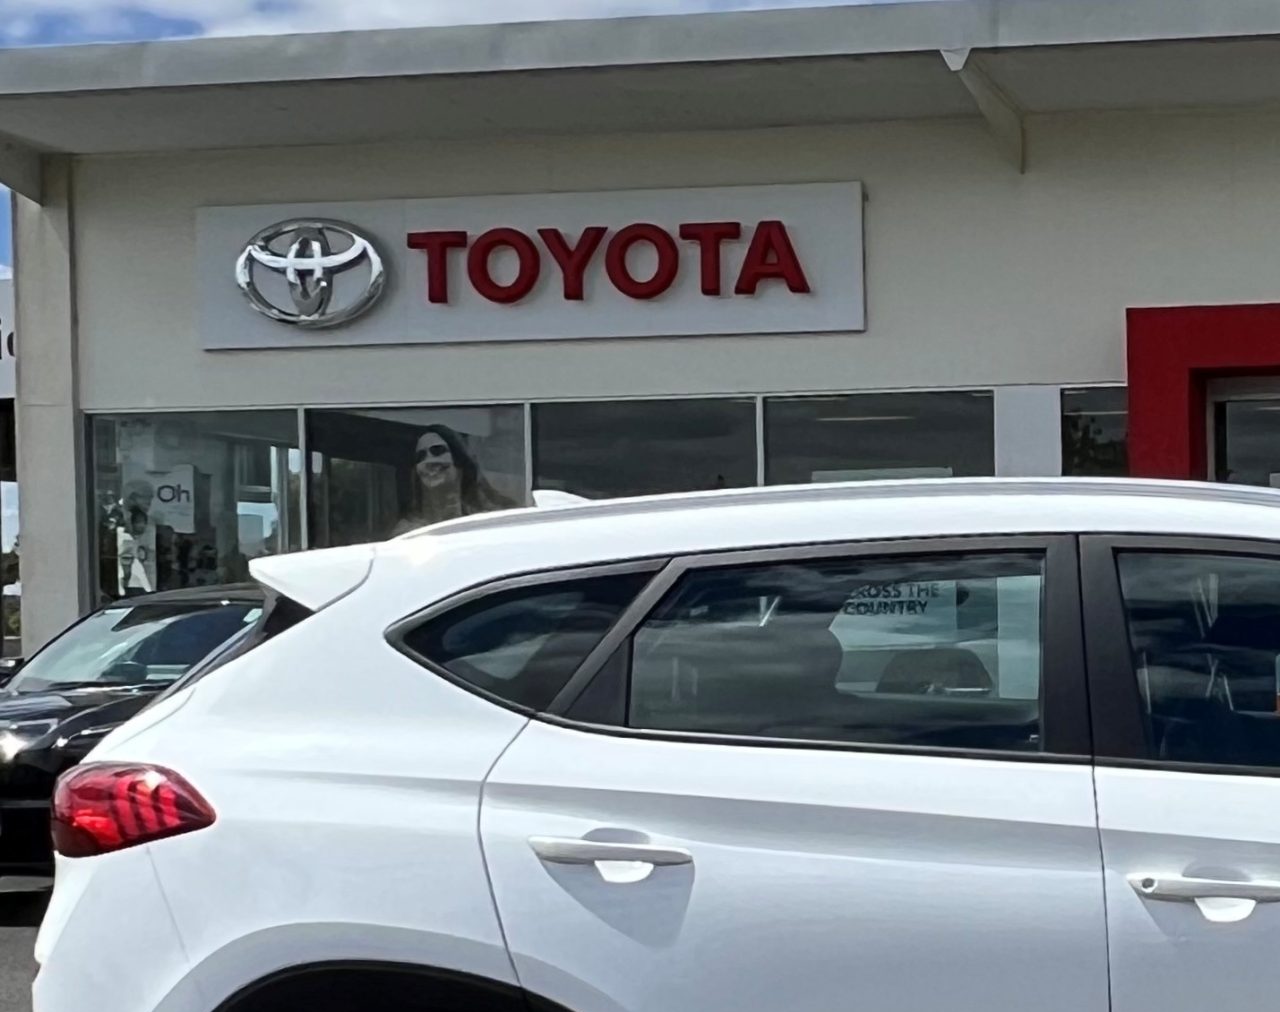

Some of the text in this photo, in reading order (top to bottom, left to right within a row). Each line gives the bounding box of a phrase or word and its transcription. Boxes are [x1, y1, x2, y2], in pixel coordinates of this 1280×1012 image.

[407, 220, 810, 303] TOYOTA
[907, 583, 940, 598] THE
[843, 600, 928, 615] COUNTRY
